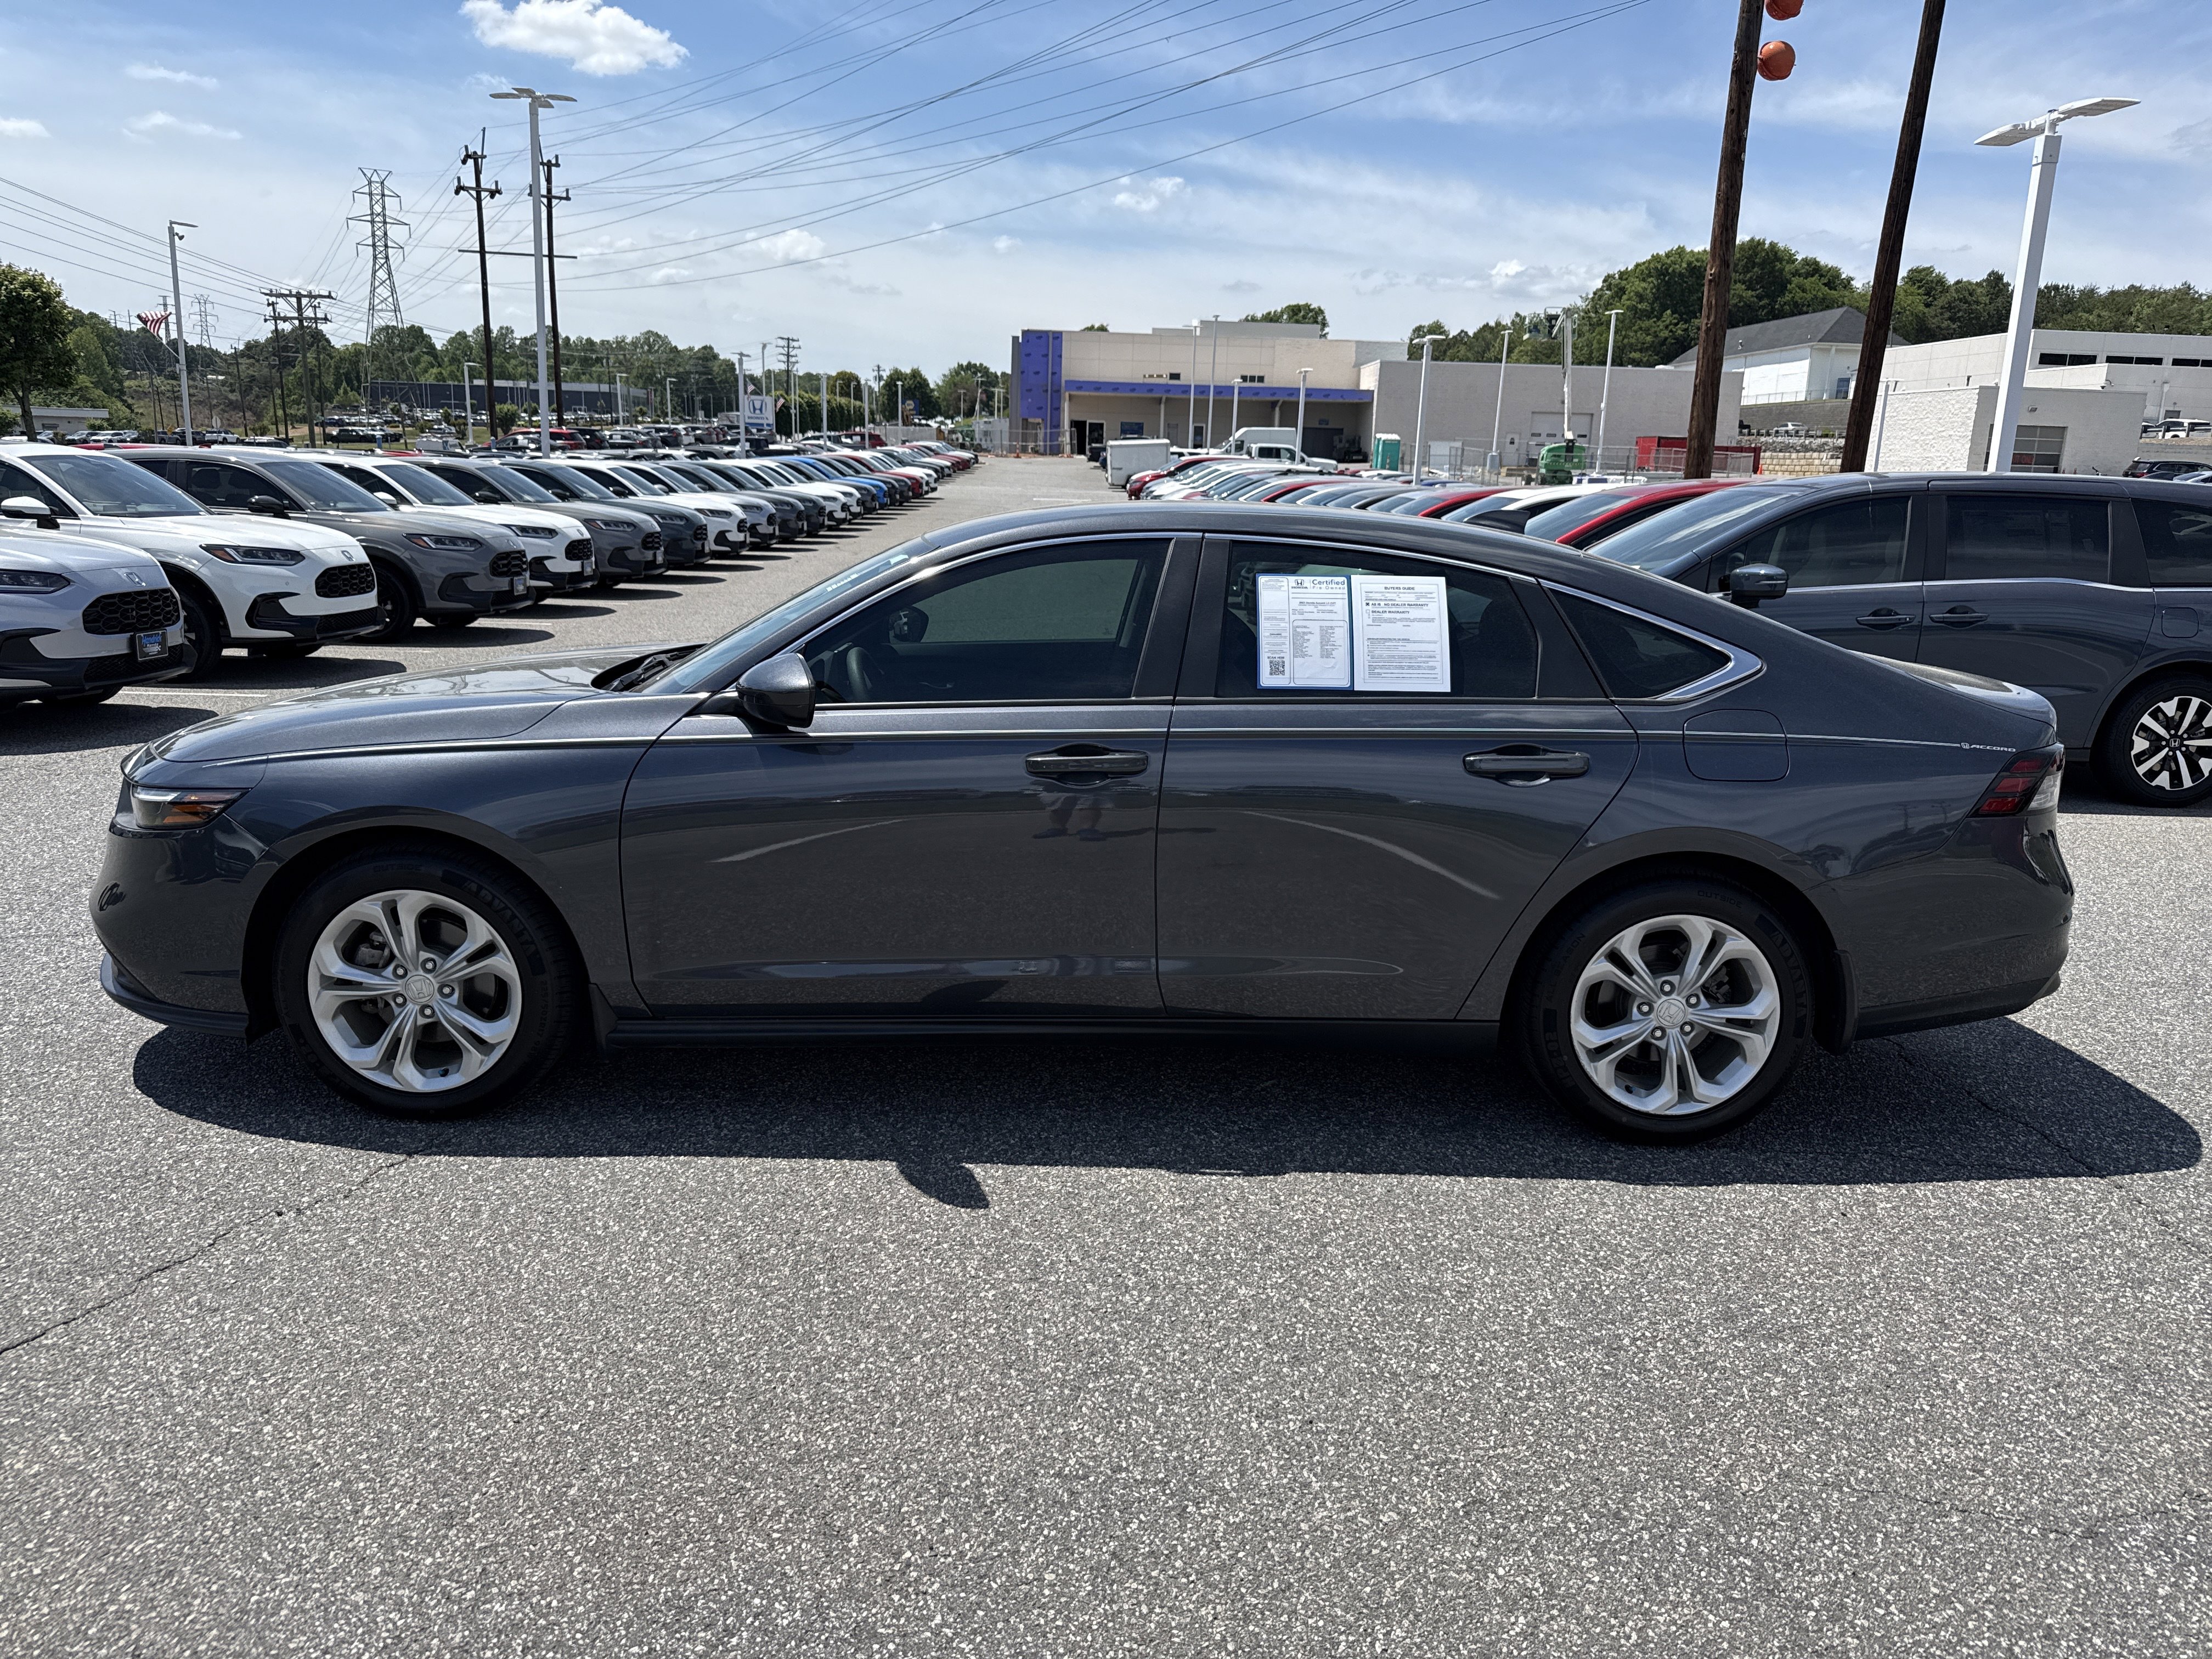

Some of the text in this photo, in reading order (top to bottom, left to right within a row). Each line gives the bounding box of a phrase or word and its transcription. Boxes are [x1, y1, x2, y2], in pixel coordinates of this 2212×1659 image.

[373, 862, 422, 873] OUTSIDE
[460, 878, 539, 961] ADVANTA
[1697, 889, 1743, 909] OUTSIDE
[1553, 932, 1586, 978] SEASON
[1770, 929, 1807, 1018] ADVANTA
